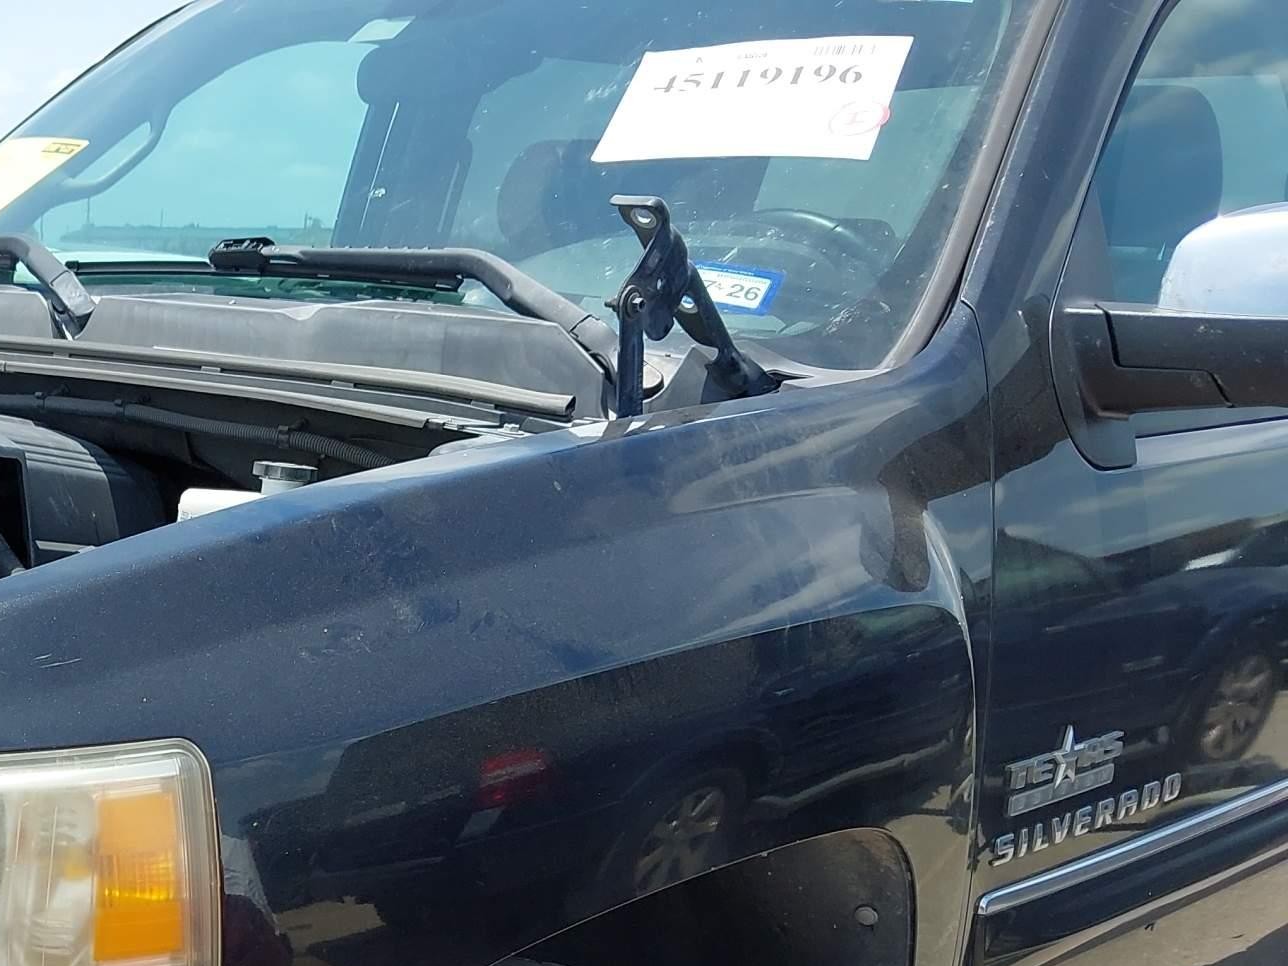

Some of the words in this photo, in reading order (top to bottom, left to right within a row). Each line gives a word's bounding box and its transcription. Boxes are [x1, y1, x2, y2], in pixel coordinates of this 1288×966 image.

[653, 64, 863, 93] 45119196
[726, 284, 761, 301] 26
[989, 772, 1182, 867] SILVERADO
